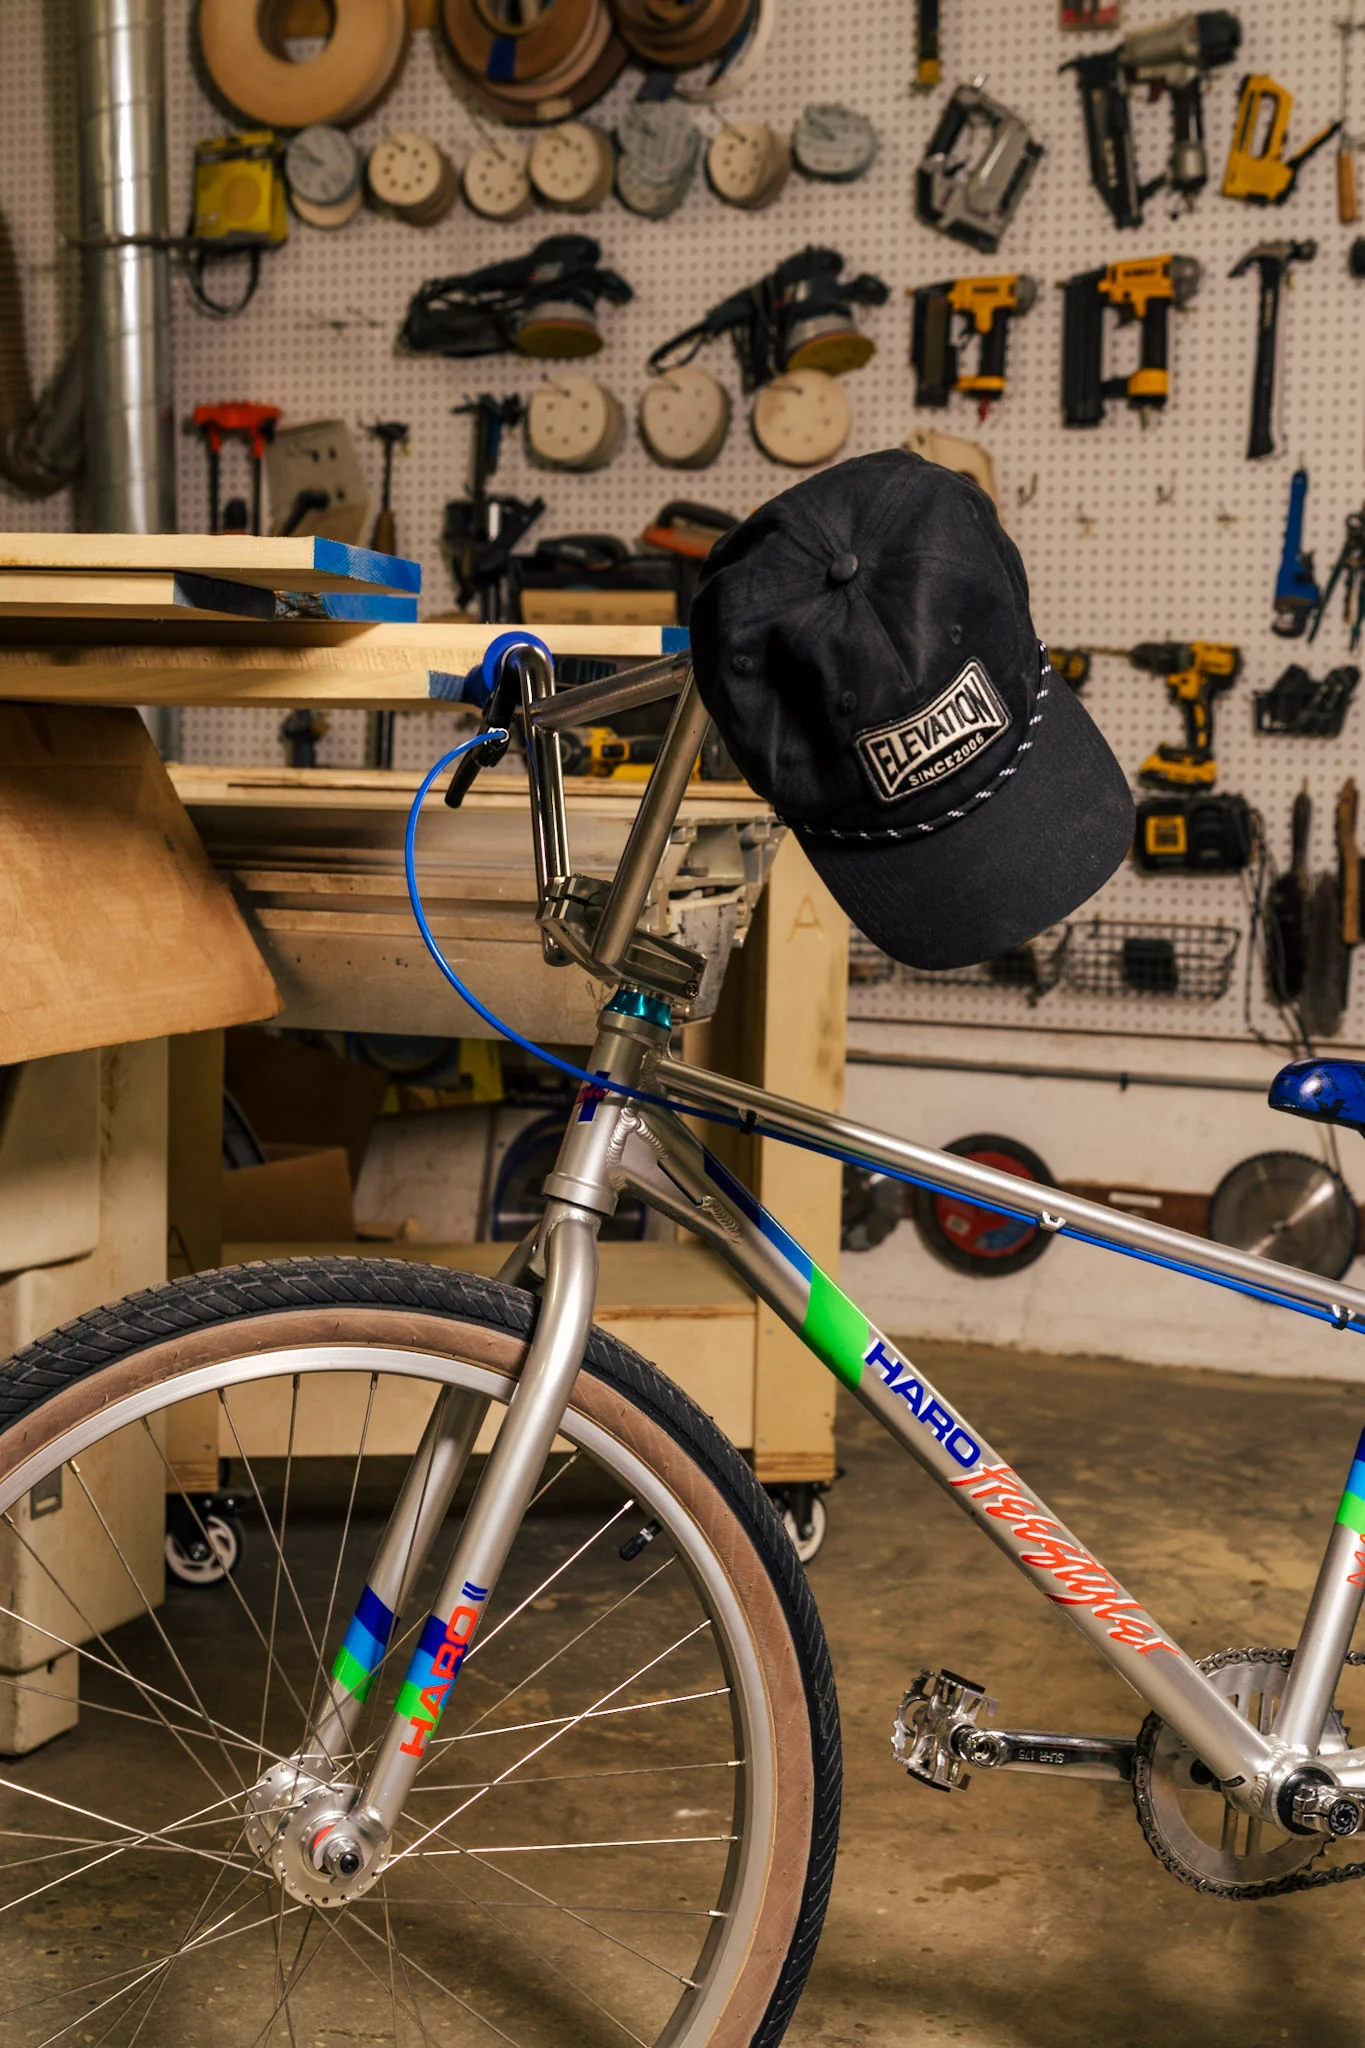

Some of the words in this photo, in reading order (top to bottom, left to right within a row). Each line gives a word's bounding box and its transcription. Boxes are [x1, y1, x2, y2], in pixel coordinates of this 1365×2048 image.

[869, 676, 997, 778] ELEVATION
[785, 894, 825, 943] A
[861, 1338, 982, 1469] HARO
[399, 1605, 479, 1758] HARO
[1019, 1749, 1035, 1761] 175
